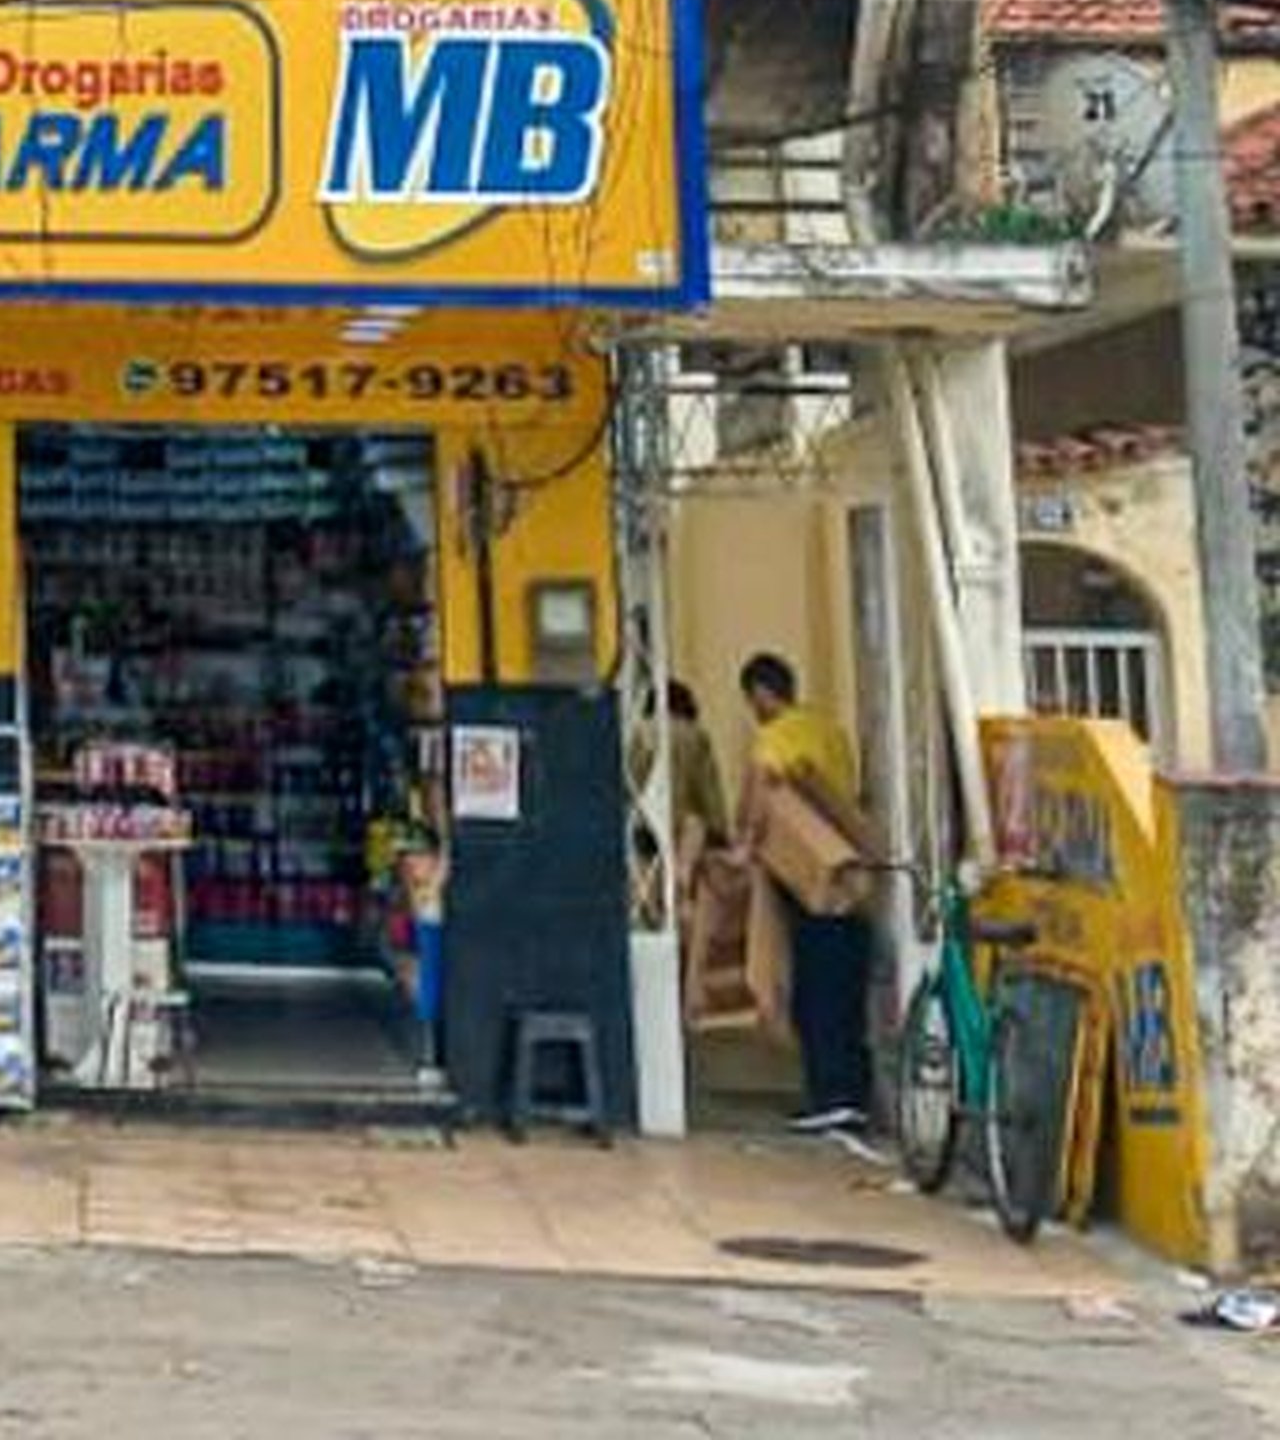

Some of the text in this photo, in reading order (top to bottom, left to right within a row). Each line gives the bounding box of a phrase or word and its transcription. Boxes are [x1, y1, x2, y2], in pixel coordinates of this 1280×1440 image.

[342, 6, 558, 31] DROGARIAS
[320, 30, 612, 202] MB
[167, 361, 574, 400] 97517-9263
